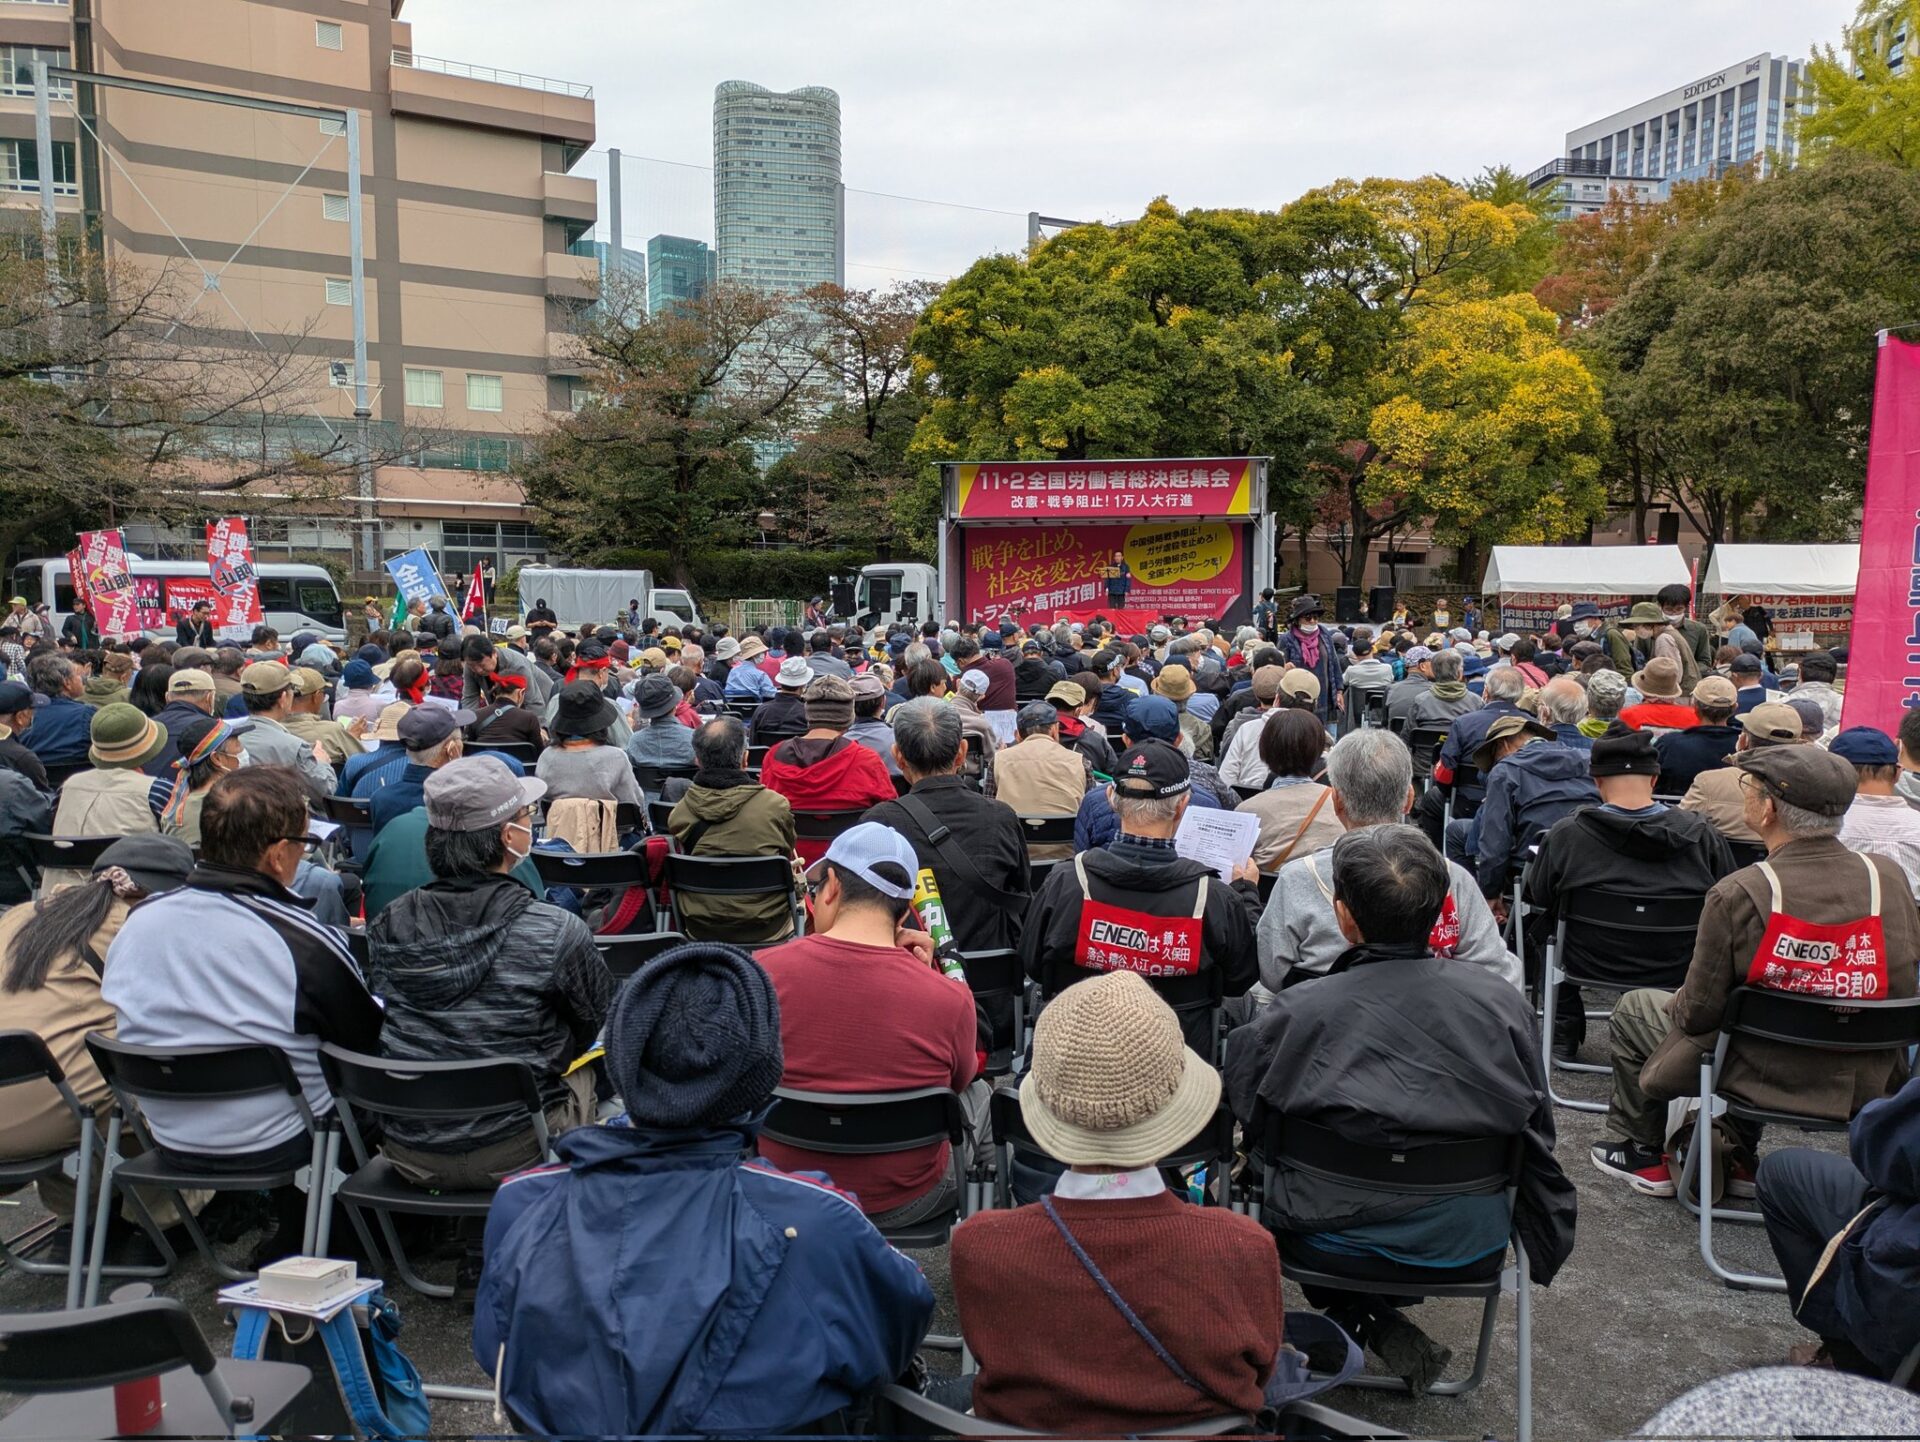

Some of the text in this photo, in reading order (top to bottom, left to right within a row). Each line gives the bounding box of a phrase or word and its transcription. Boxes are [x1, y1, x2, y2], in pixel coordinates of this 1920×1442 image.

[1683, 73, 1726, 100] EDITION
[971, 528, 1083, 573] 戦争を止め、
[1161, 947, 1190, 962] 久保田
[1835, 971, 1877, 997] 8君の
